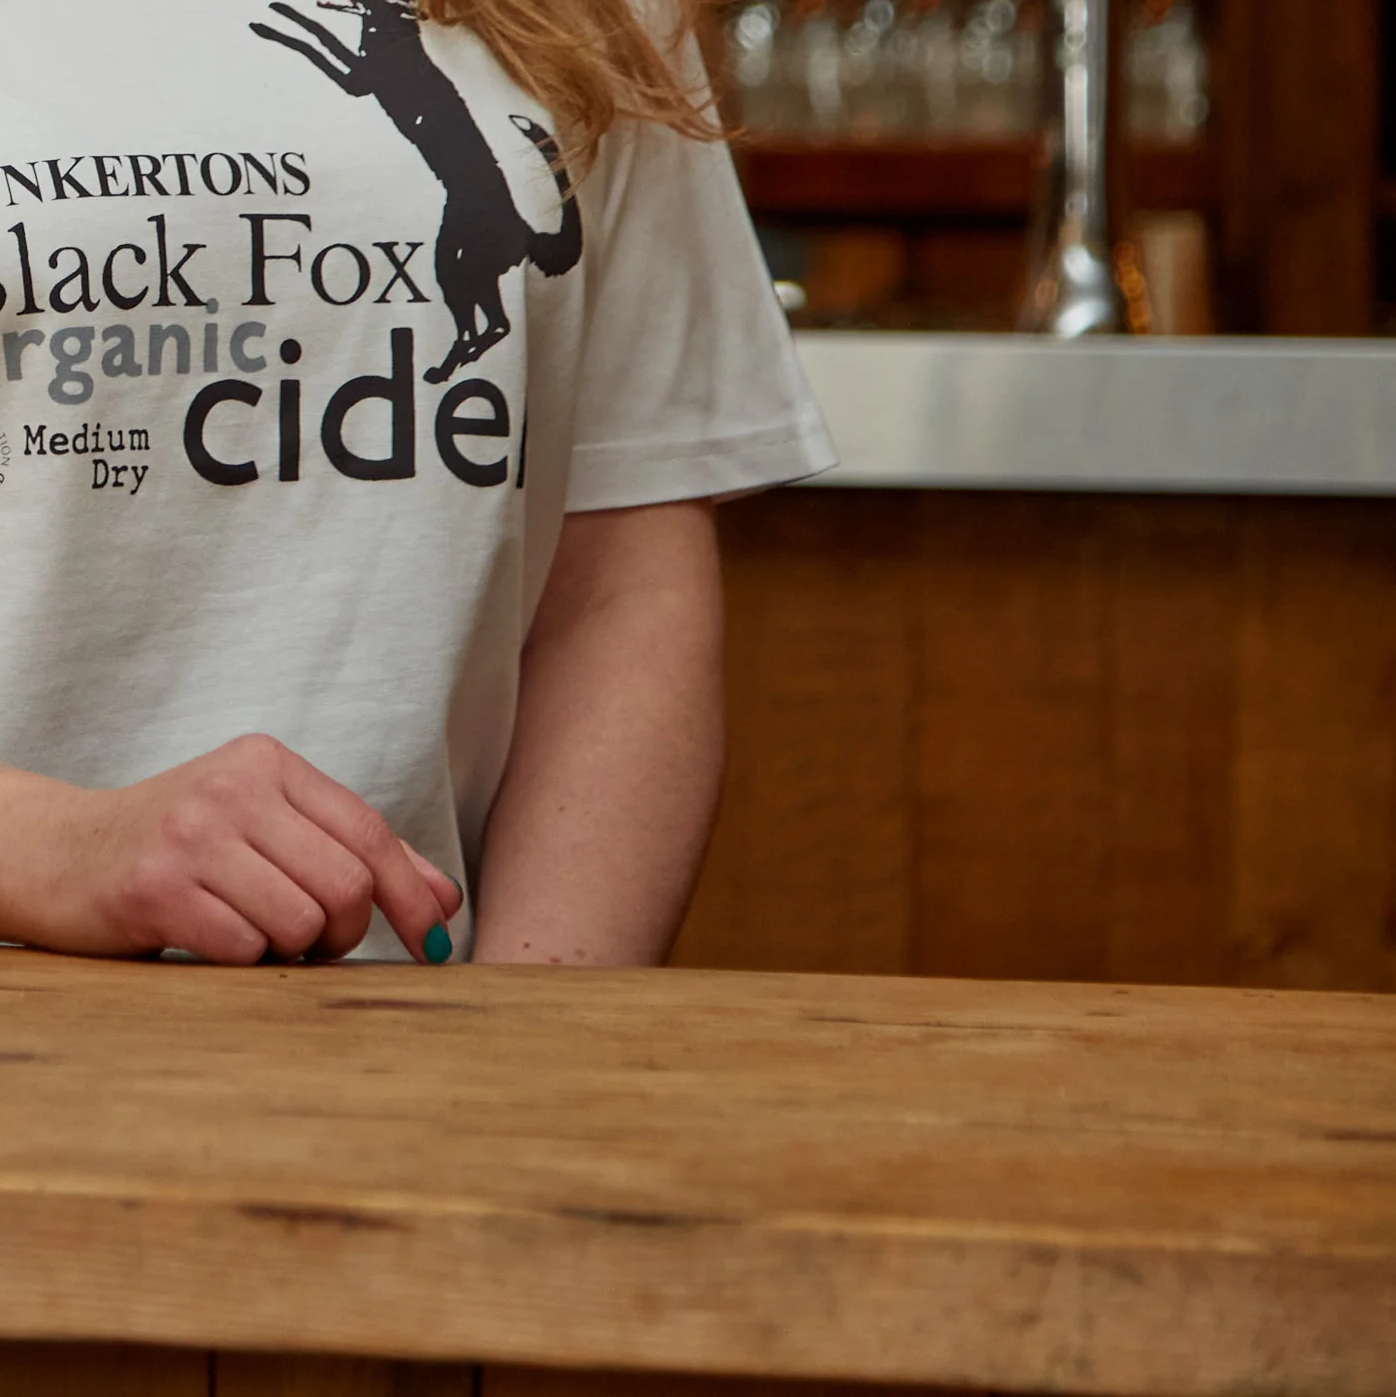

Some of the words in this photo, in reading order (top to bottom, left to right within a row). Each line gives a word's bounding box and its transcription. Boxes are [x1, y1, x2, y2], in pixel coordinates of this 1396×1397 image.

[239, 213, 432, 306] Fox
[23, 422, 150, 455] Medium
[183, 327, 527, 489] cide
[91, 459, 149, 495] Dry
